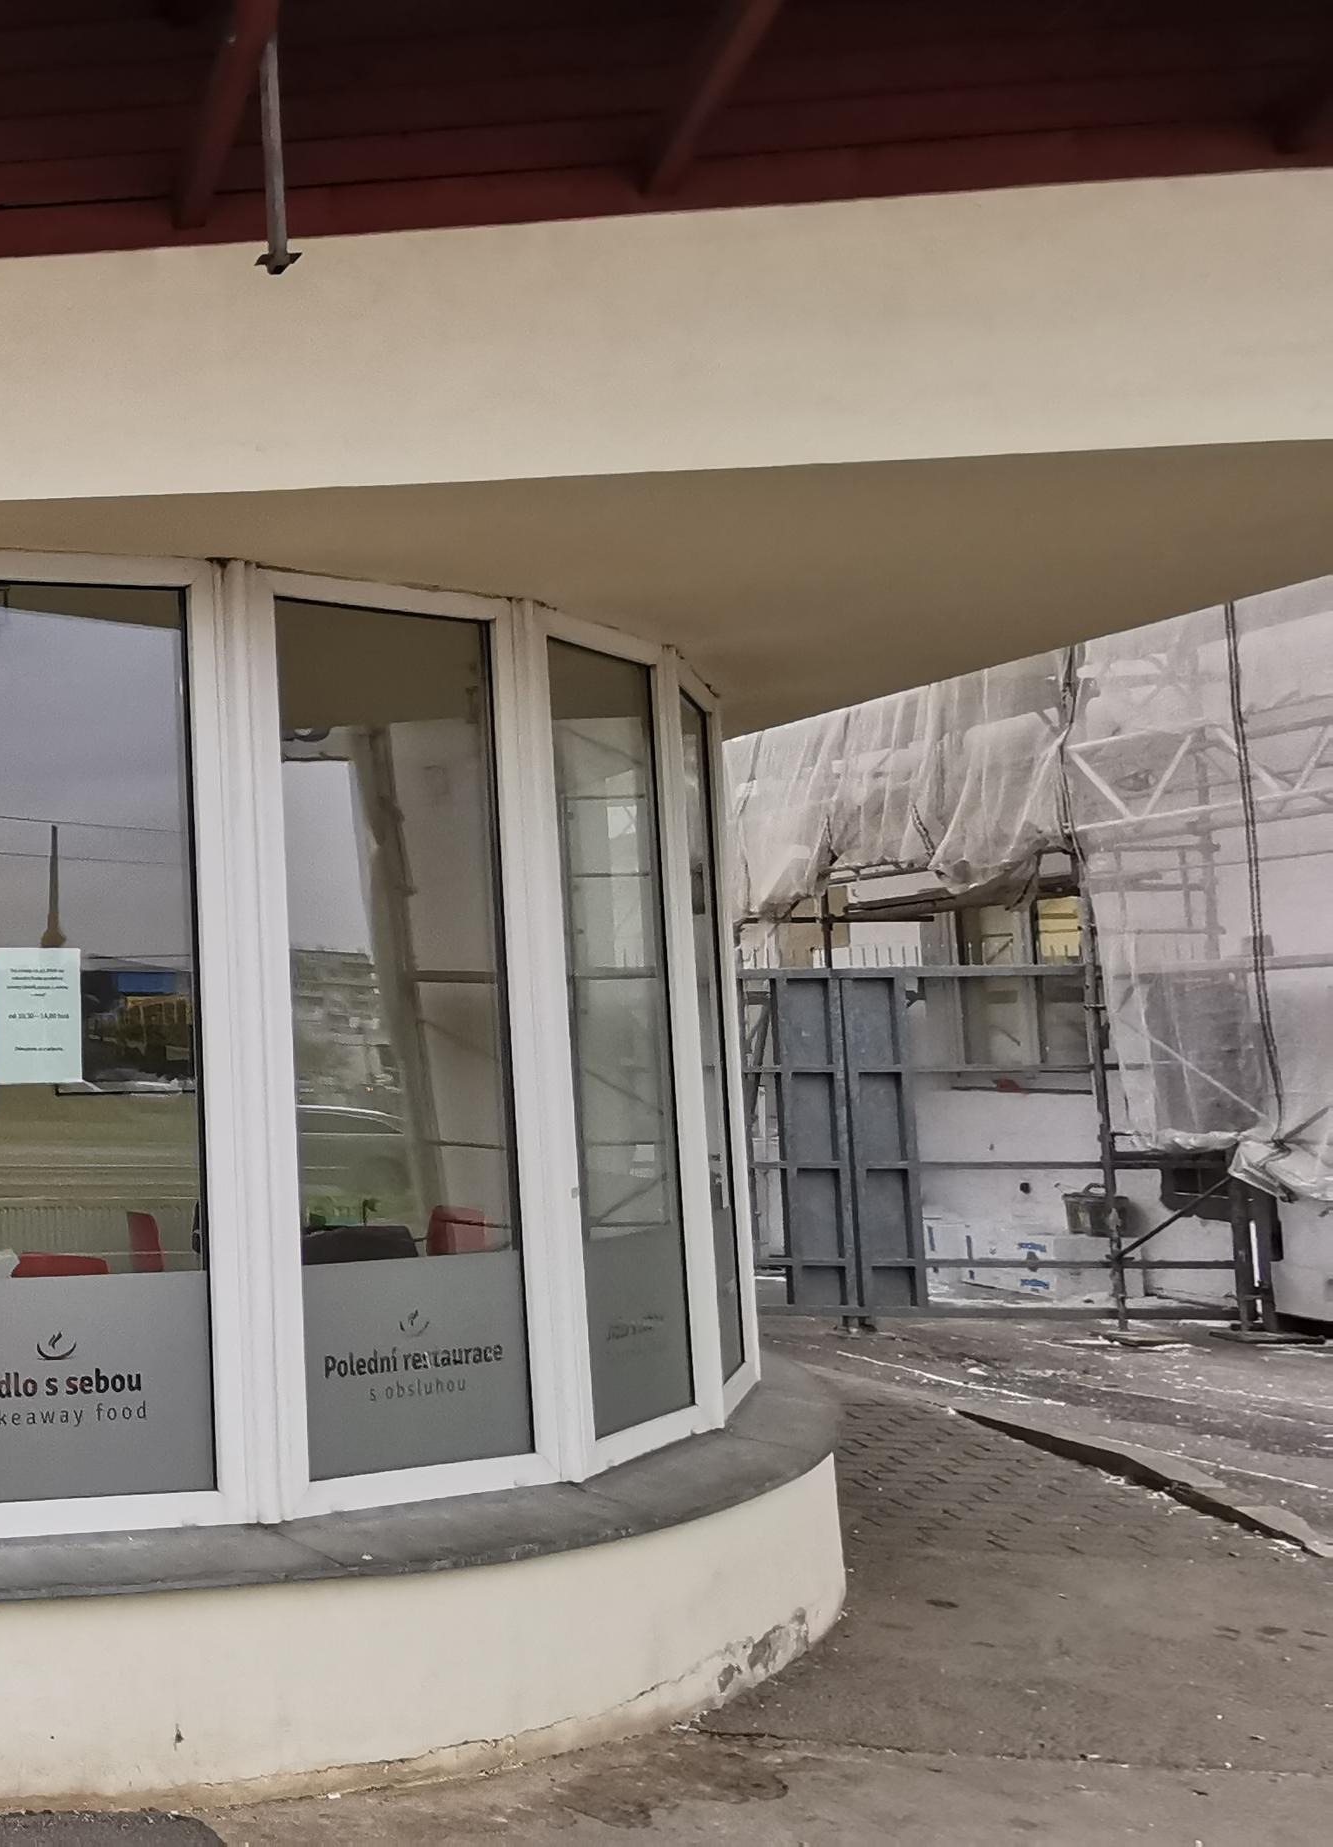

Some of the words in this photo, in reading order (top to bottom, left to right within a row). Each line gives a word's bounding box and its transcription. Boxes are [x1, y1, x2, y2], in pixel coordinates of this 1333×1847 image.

[323, 1346, 398, 1379] Polední
[44, 1377, 59, 1397] s
[65, 1367, 142, 1396] sebou
[369, 1388, 377, 1402] s
[384, 1377, 467, 1401] obsluhou
[96, 1400, 148, 1422] food
